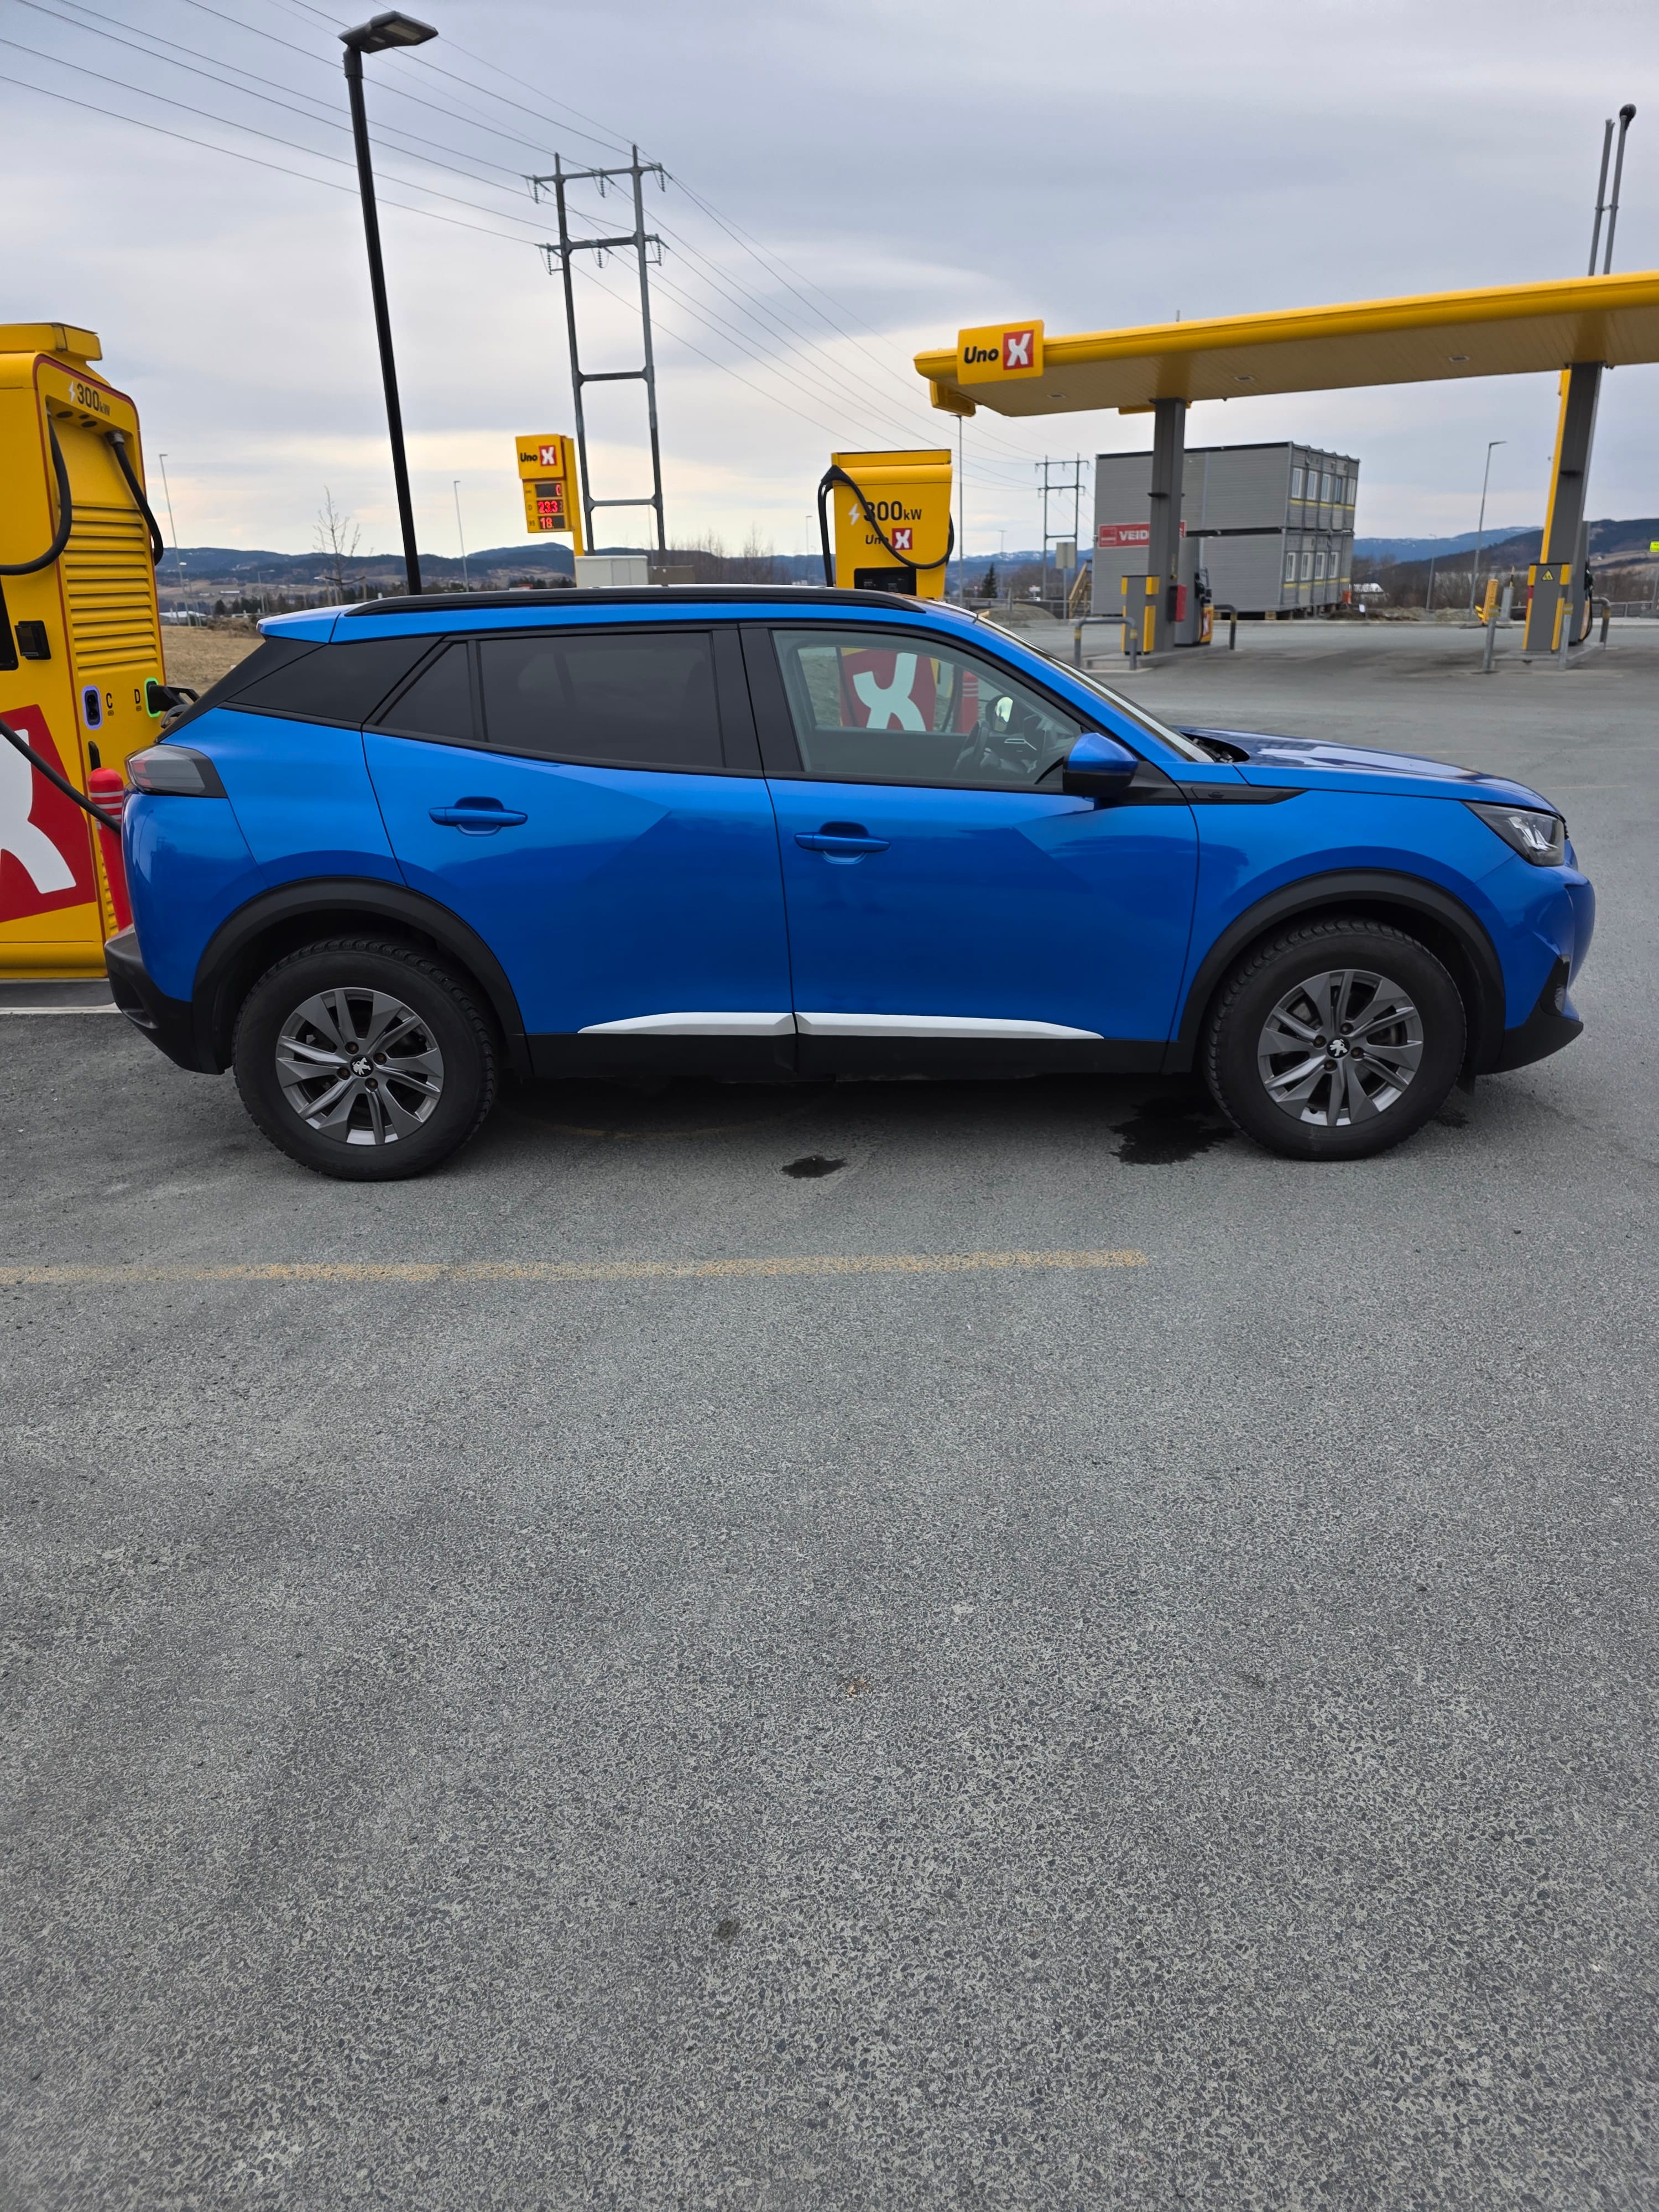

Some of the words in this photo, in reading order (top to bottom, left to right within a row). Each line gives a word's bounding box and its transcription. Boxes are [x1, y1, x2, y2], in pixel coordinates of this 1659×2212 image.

[964, 346, 999, 364] Uno
[1006, 333, 1031, 367] X
[520, 452, 538, 462] Uno
[541, 446, 555, 465] X
[895, 529, 911, 549] X
[1119, 530, 1150, 541] VEID
[106, 692, 113, 709] C
[134, 688, 140, 704] D
